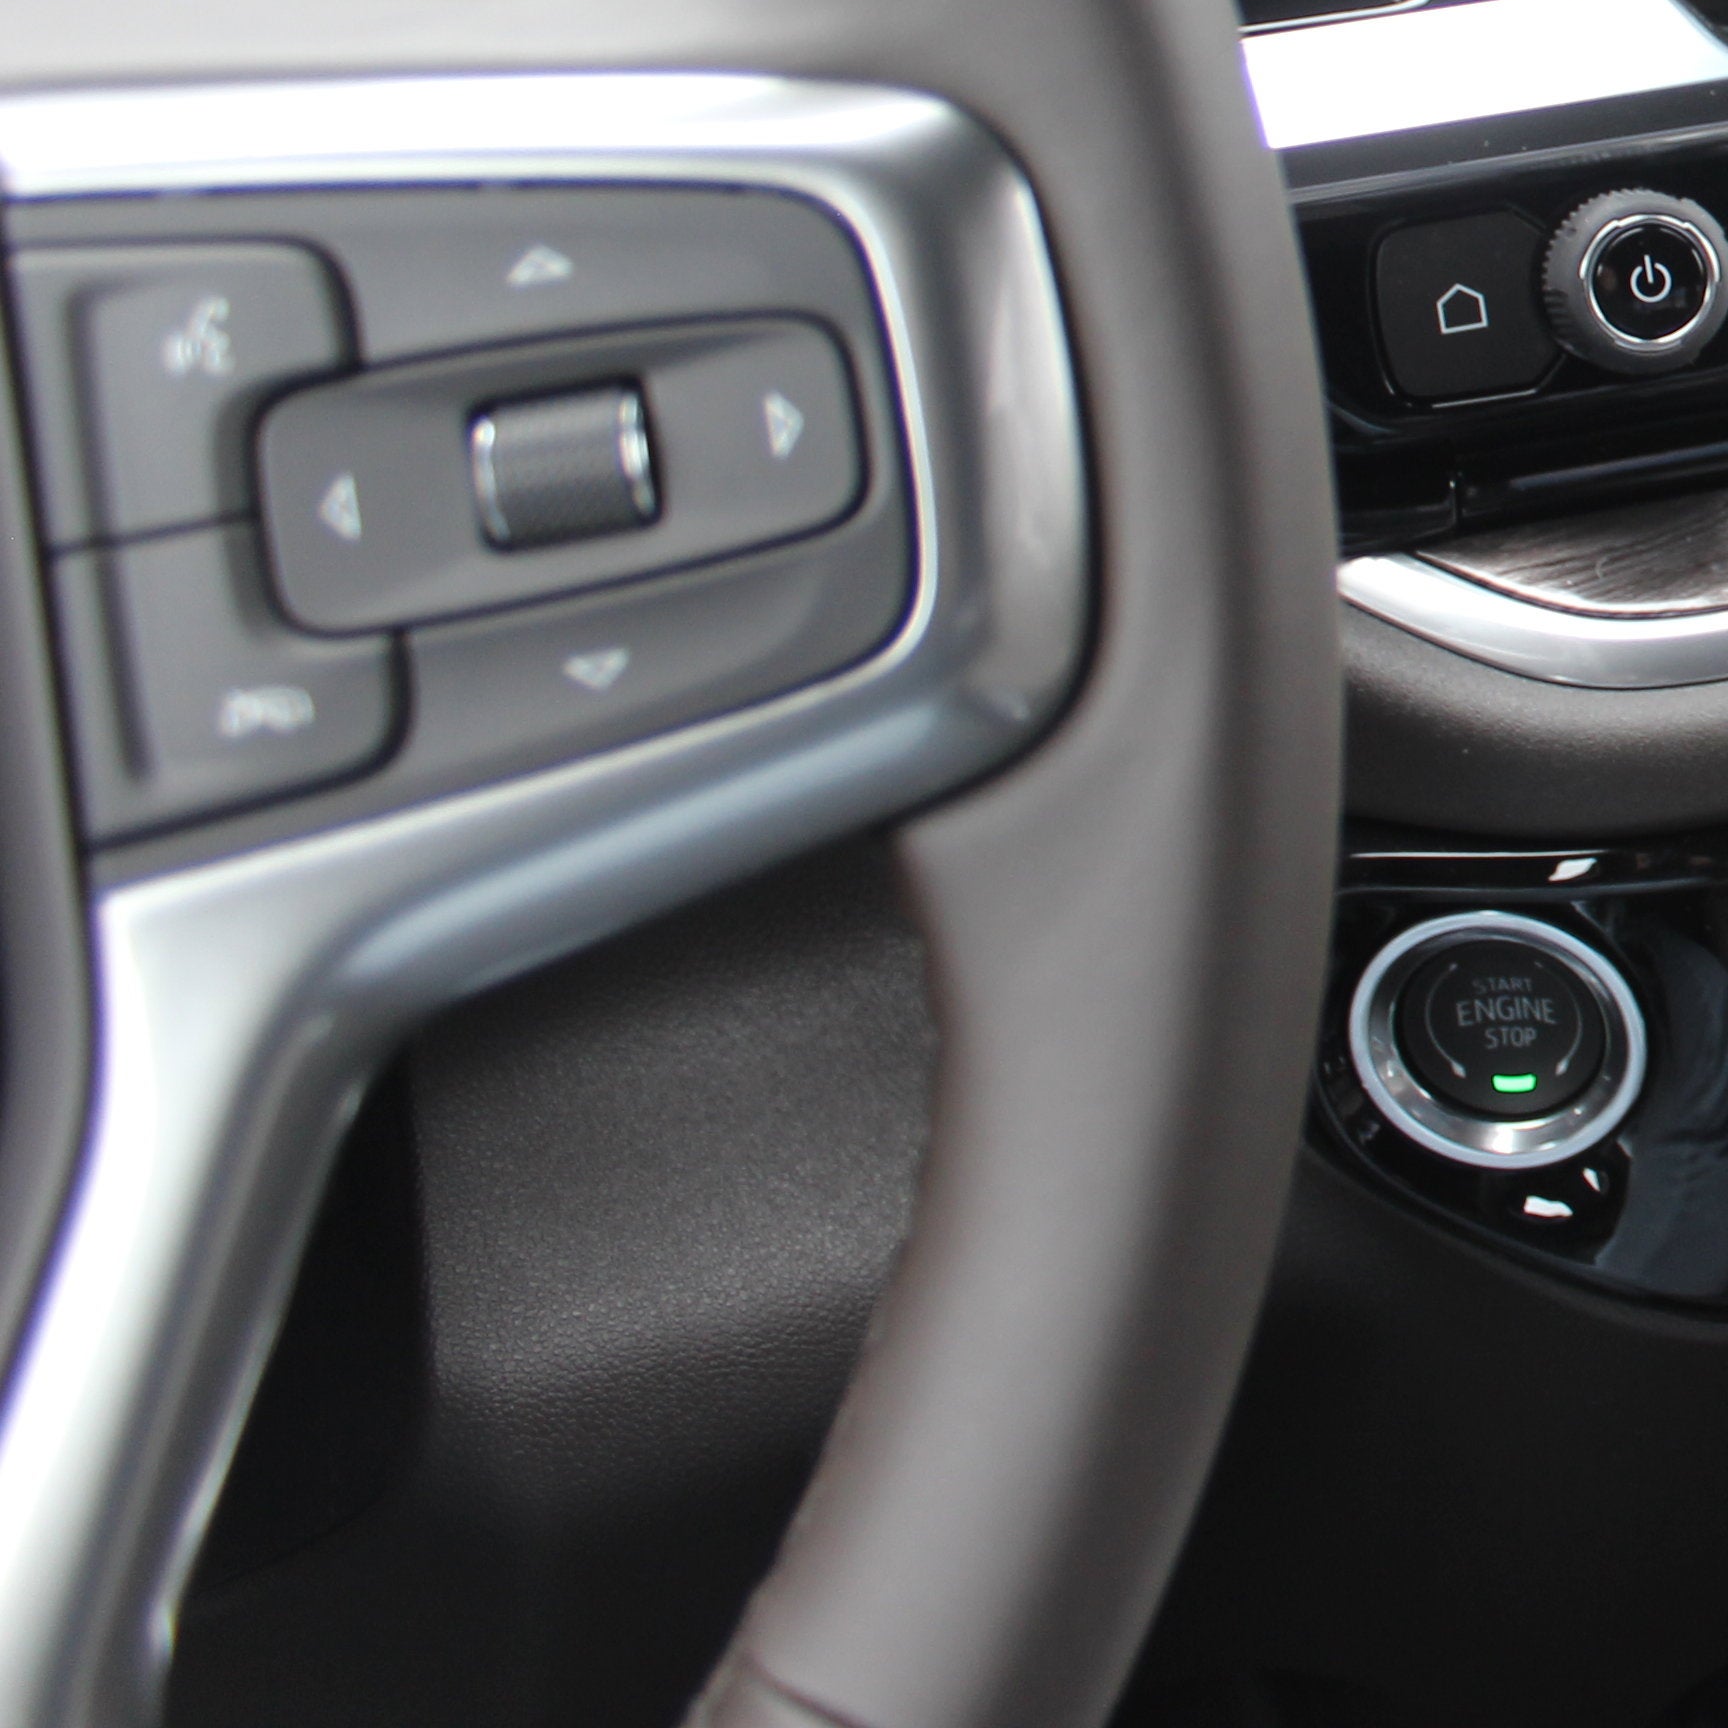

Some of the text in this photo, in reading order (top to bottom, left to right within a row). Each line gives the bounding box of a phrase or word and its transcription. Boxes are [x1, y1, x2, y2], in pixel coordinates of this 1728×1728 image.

[1472, 977, 1533, 994] START
[1456, 996, 1557, 1027] ENGINE
[1485, 1027, 1537, 1050] STOP
